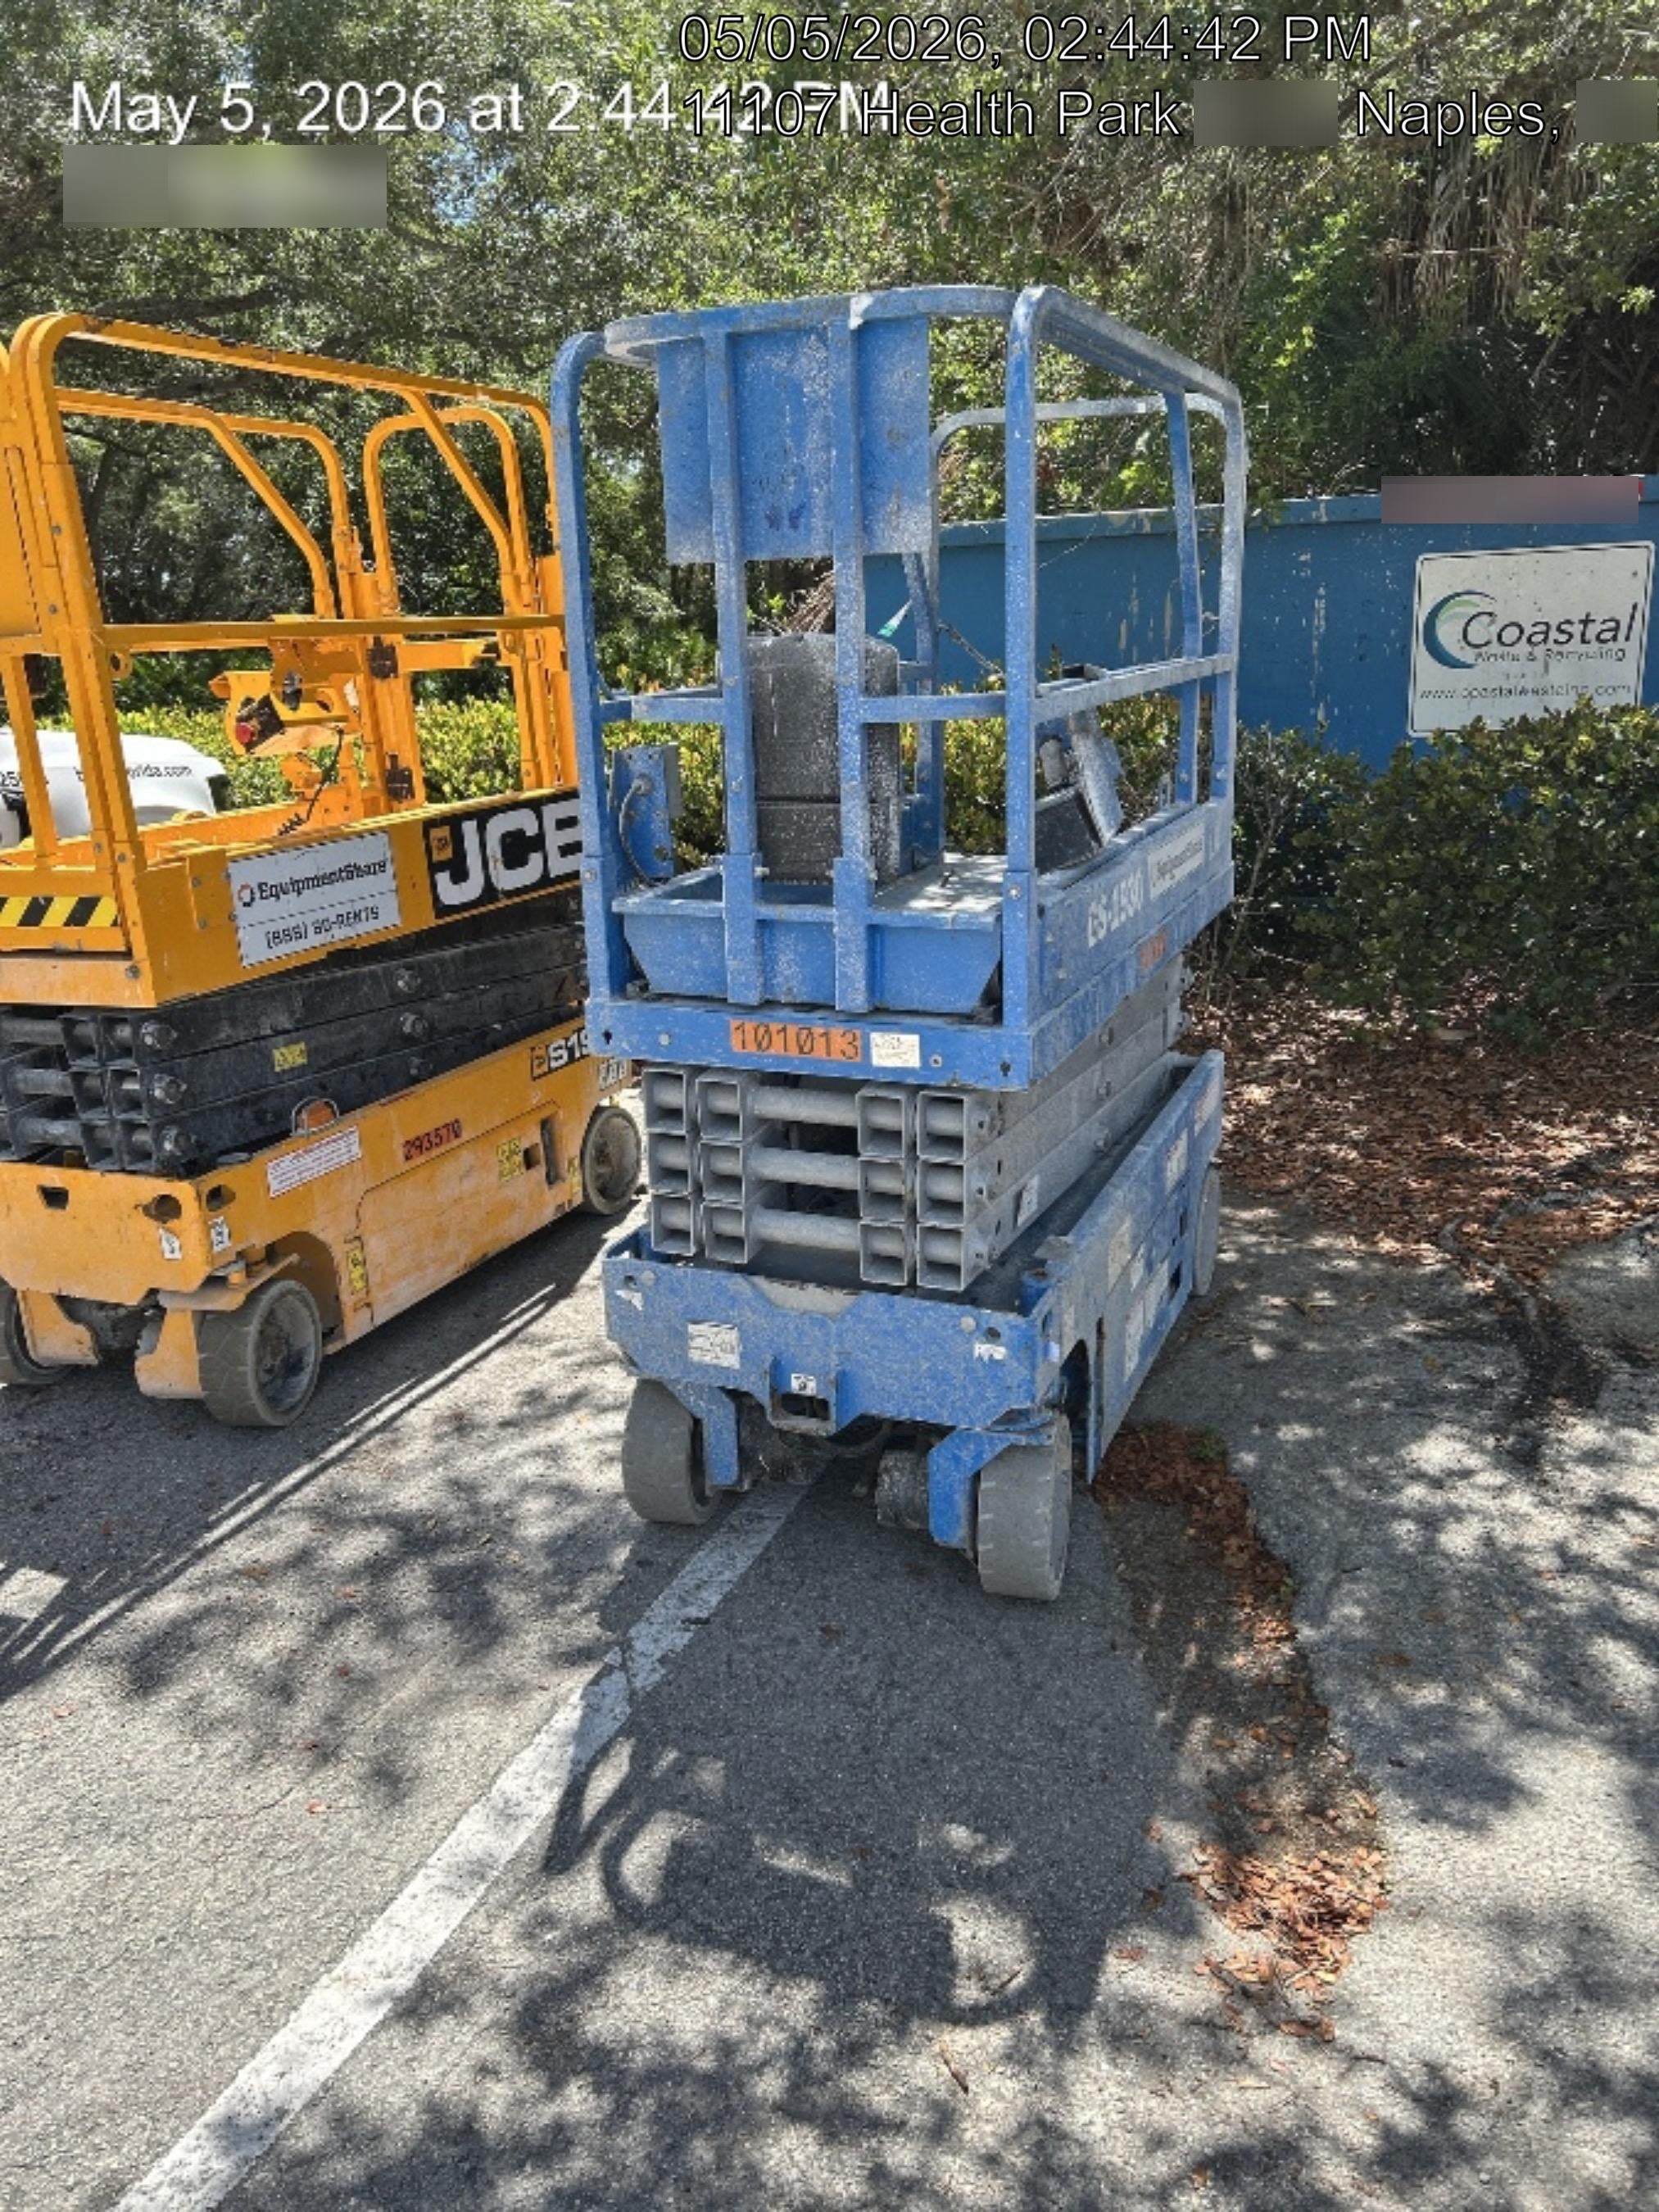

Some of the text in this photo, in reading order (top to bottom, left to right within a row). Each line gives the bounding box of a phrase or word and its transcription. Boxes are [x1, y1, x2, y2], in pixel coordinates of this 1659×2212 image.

[1462, 601, 1639, 649] Coastal
[257, 859, 388, 901] EquipmentShare
[734, 1022, 859, 1060] 101013
[403, 1118, 462, 1161] 293570
